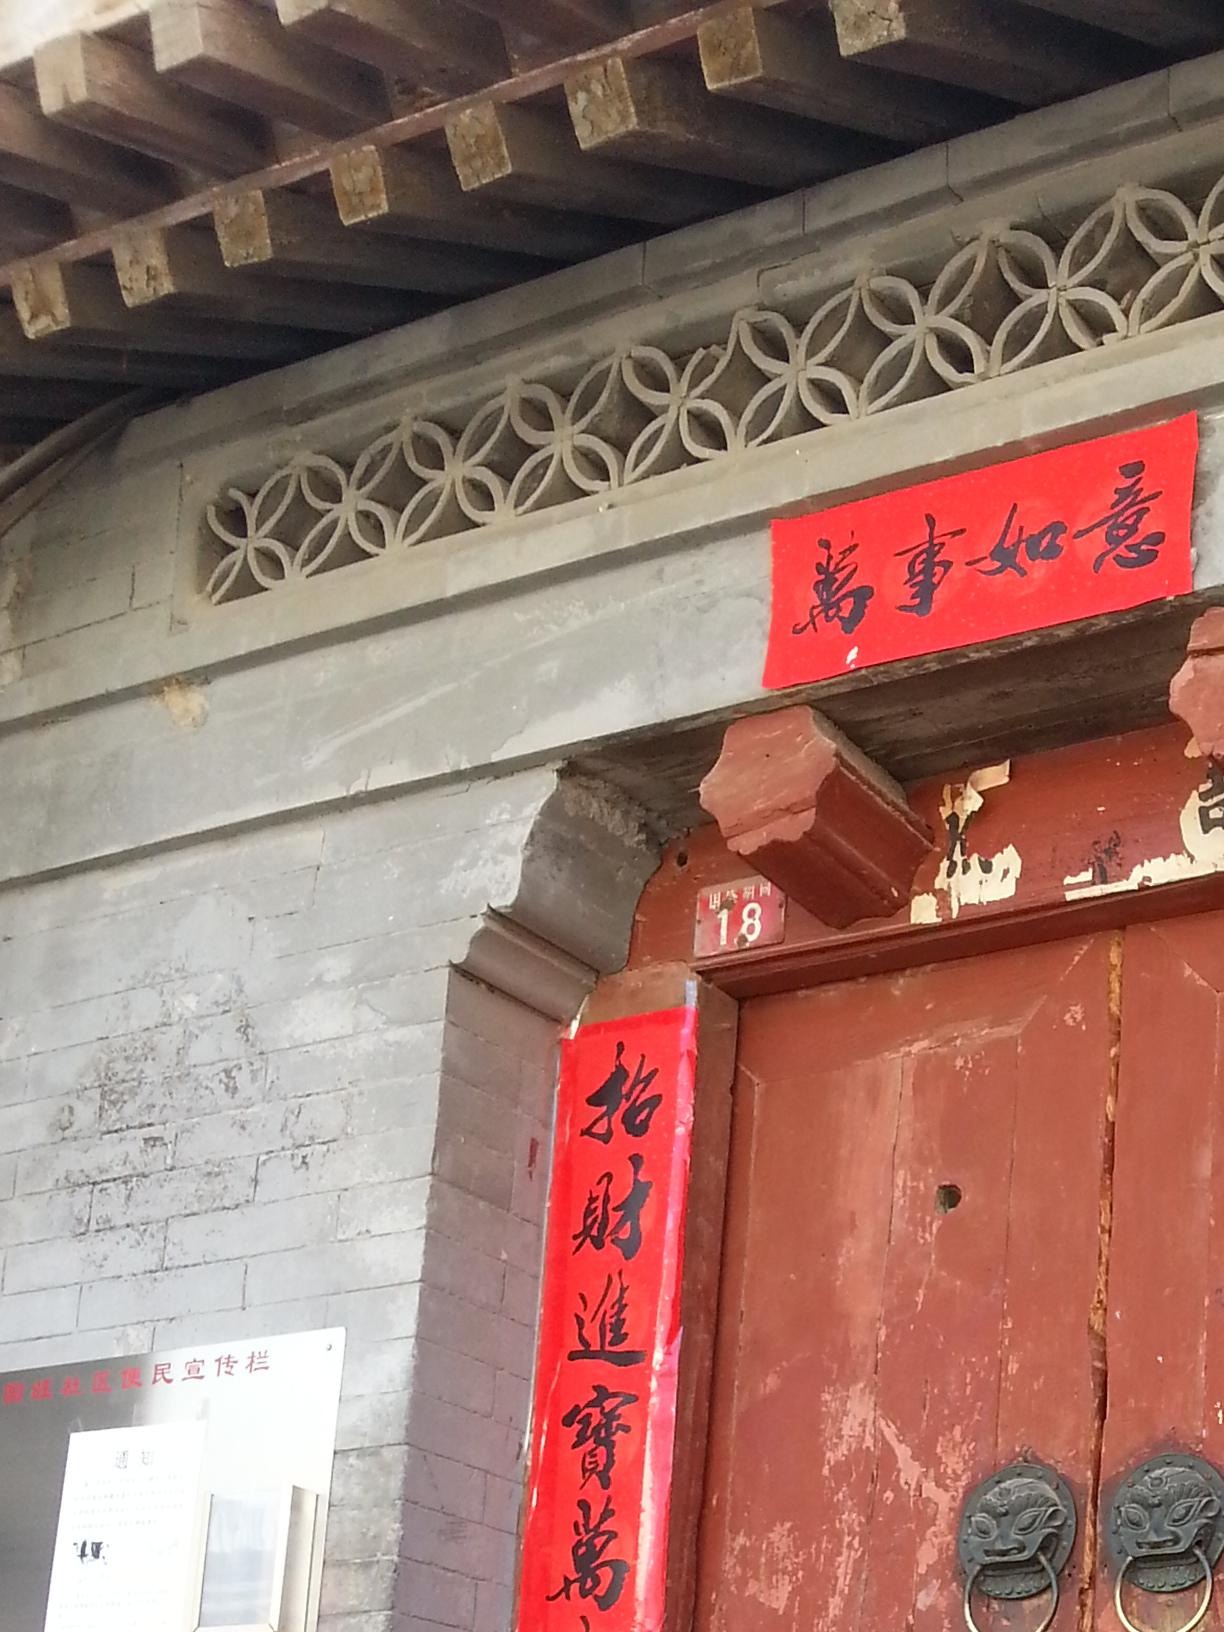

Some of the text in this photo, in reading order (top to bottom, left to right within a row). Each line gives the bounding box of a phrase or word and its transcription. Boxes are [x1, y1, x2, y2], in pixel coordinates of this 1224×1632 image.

[793, 460, 1167, 635] 萬事如意
[717, 902, 762, 946] 18
